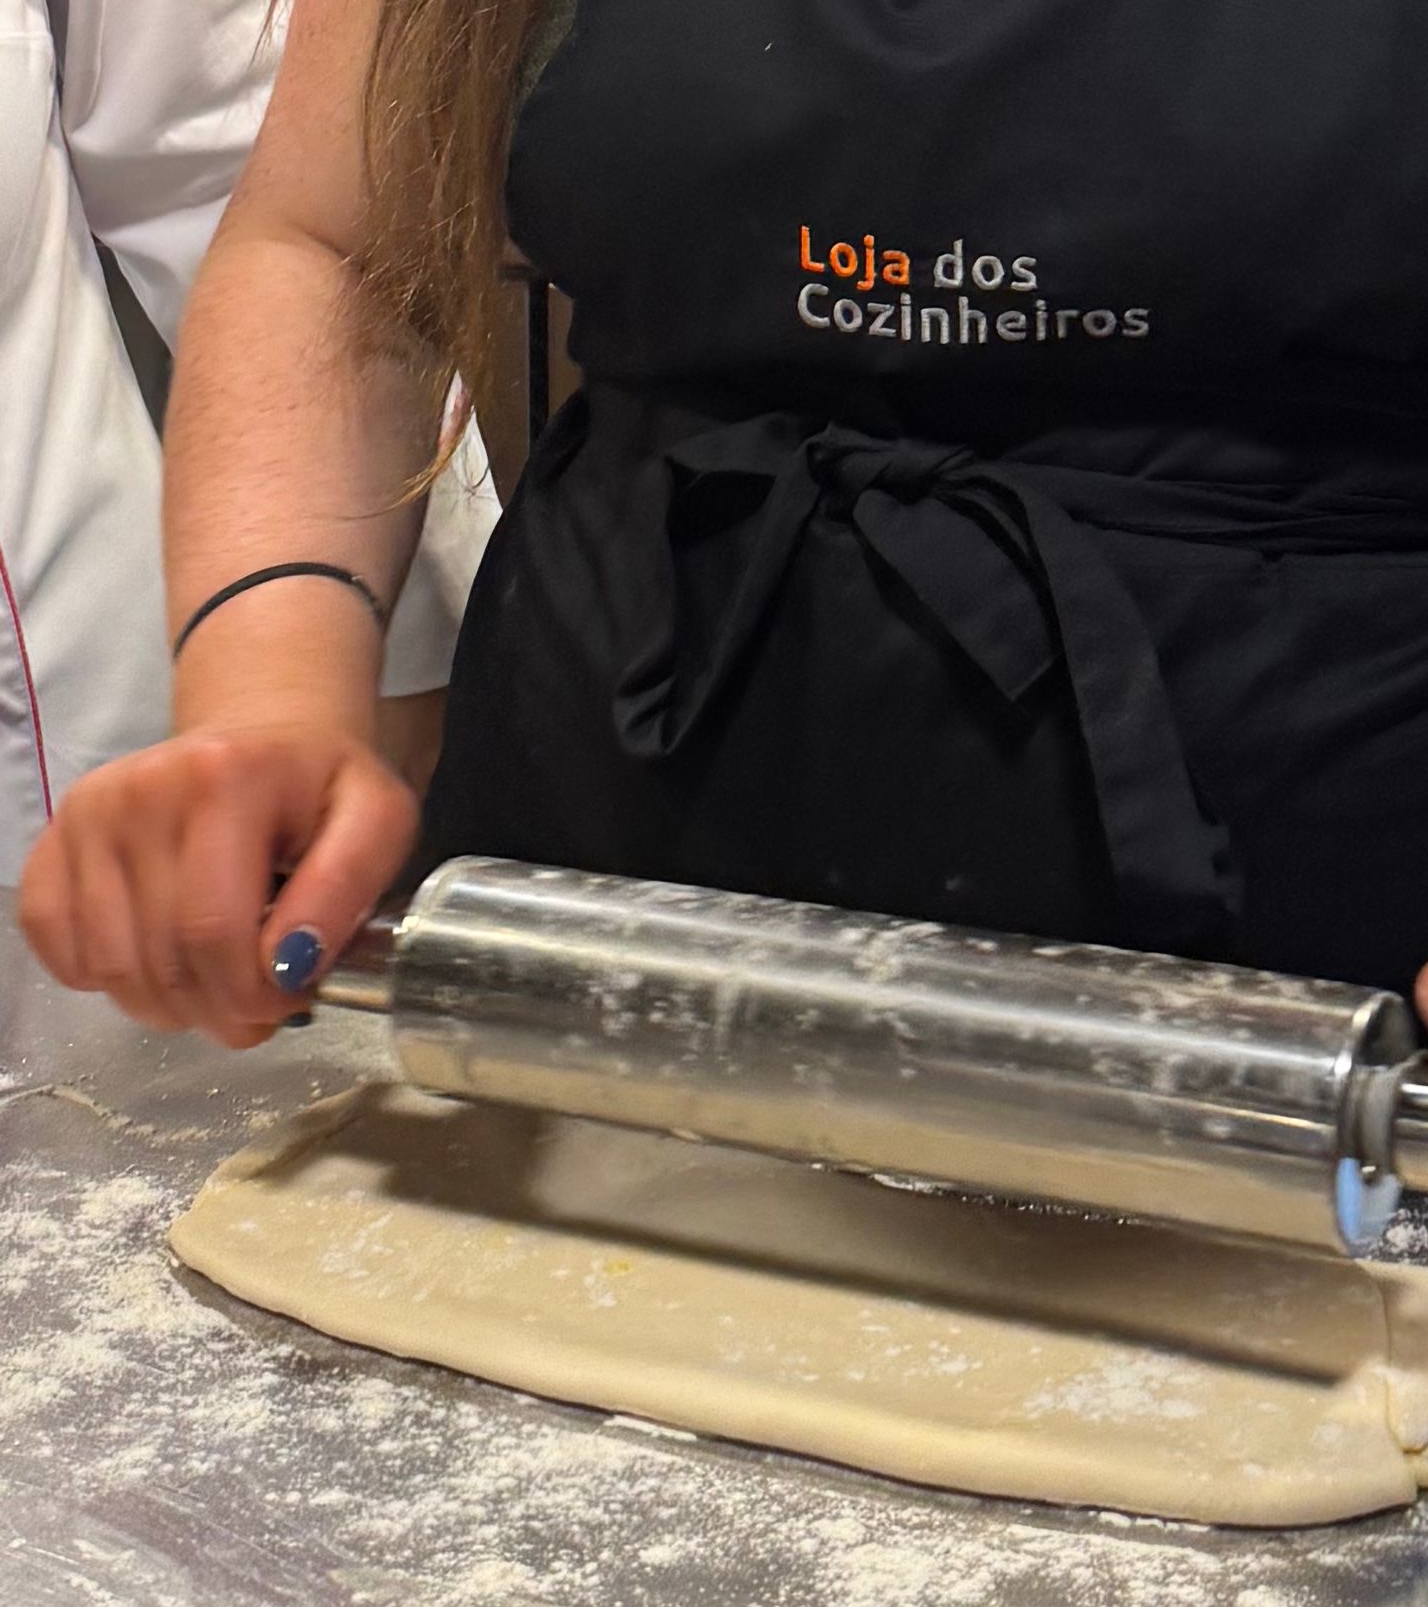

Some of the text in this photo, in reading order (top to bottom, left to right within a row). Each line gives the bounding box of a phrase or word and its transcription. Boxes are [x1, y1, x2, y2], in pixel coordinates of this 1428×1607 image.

[800, 224, 1038, 292] Loja dos
[797, 282, 1151, 345] Cozinheiros
